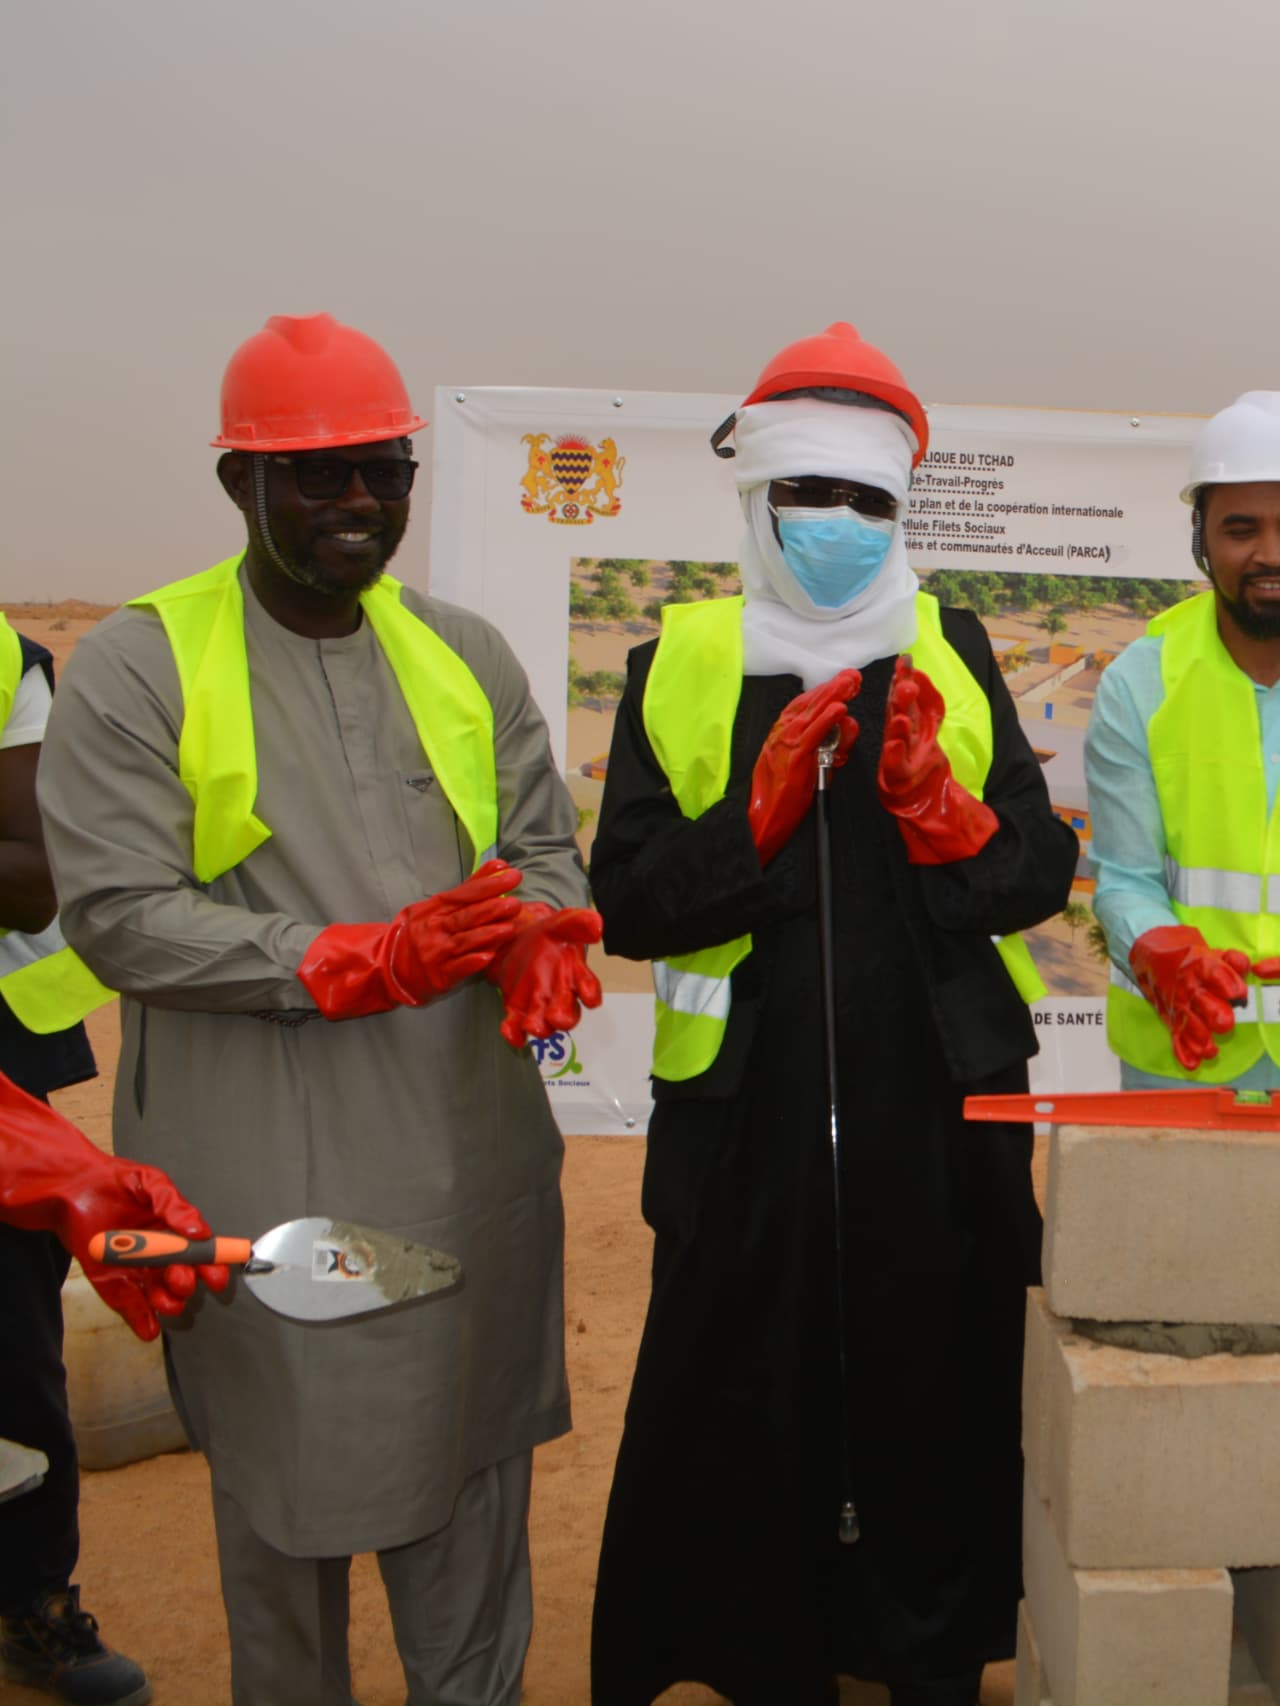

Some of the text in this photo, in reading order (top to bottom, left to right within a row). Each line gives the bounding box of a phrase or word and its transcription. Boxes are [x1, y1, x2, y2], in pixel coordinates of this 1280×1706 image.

[960, 453, 974, 465] DU
[978, 454, 1014, 467] TCHAD
[920, 498, 942, 512] plan
[945, 500, 956, 510] et
[959, 500, 971, 511] de
[974, 500, 984, 511] la
[987, 502, 1049, 516] coopération
[1052, 504, 1124, 518] internationale
[932, 520, 961, 532] Filets
[964, 521, 1006, 534] Sociaux
[927, 540, 938, 551] et
[940, 542, 1014, 554] communautés
[1016, 543, 1064, 556] d'Acceuil
[1067, 544, 1111, 563] (PARCA)
[1034, 1010, 1104, 1025] DE SANTÉ
